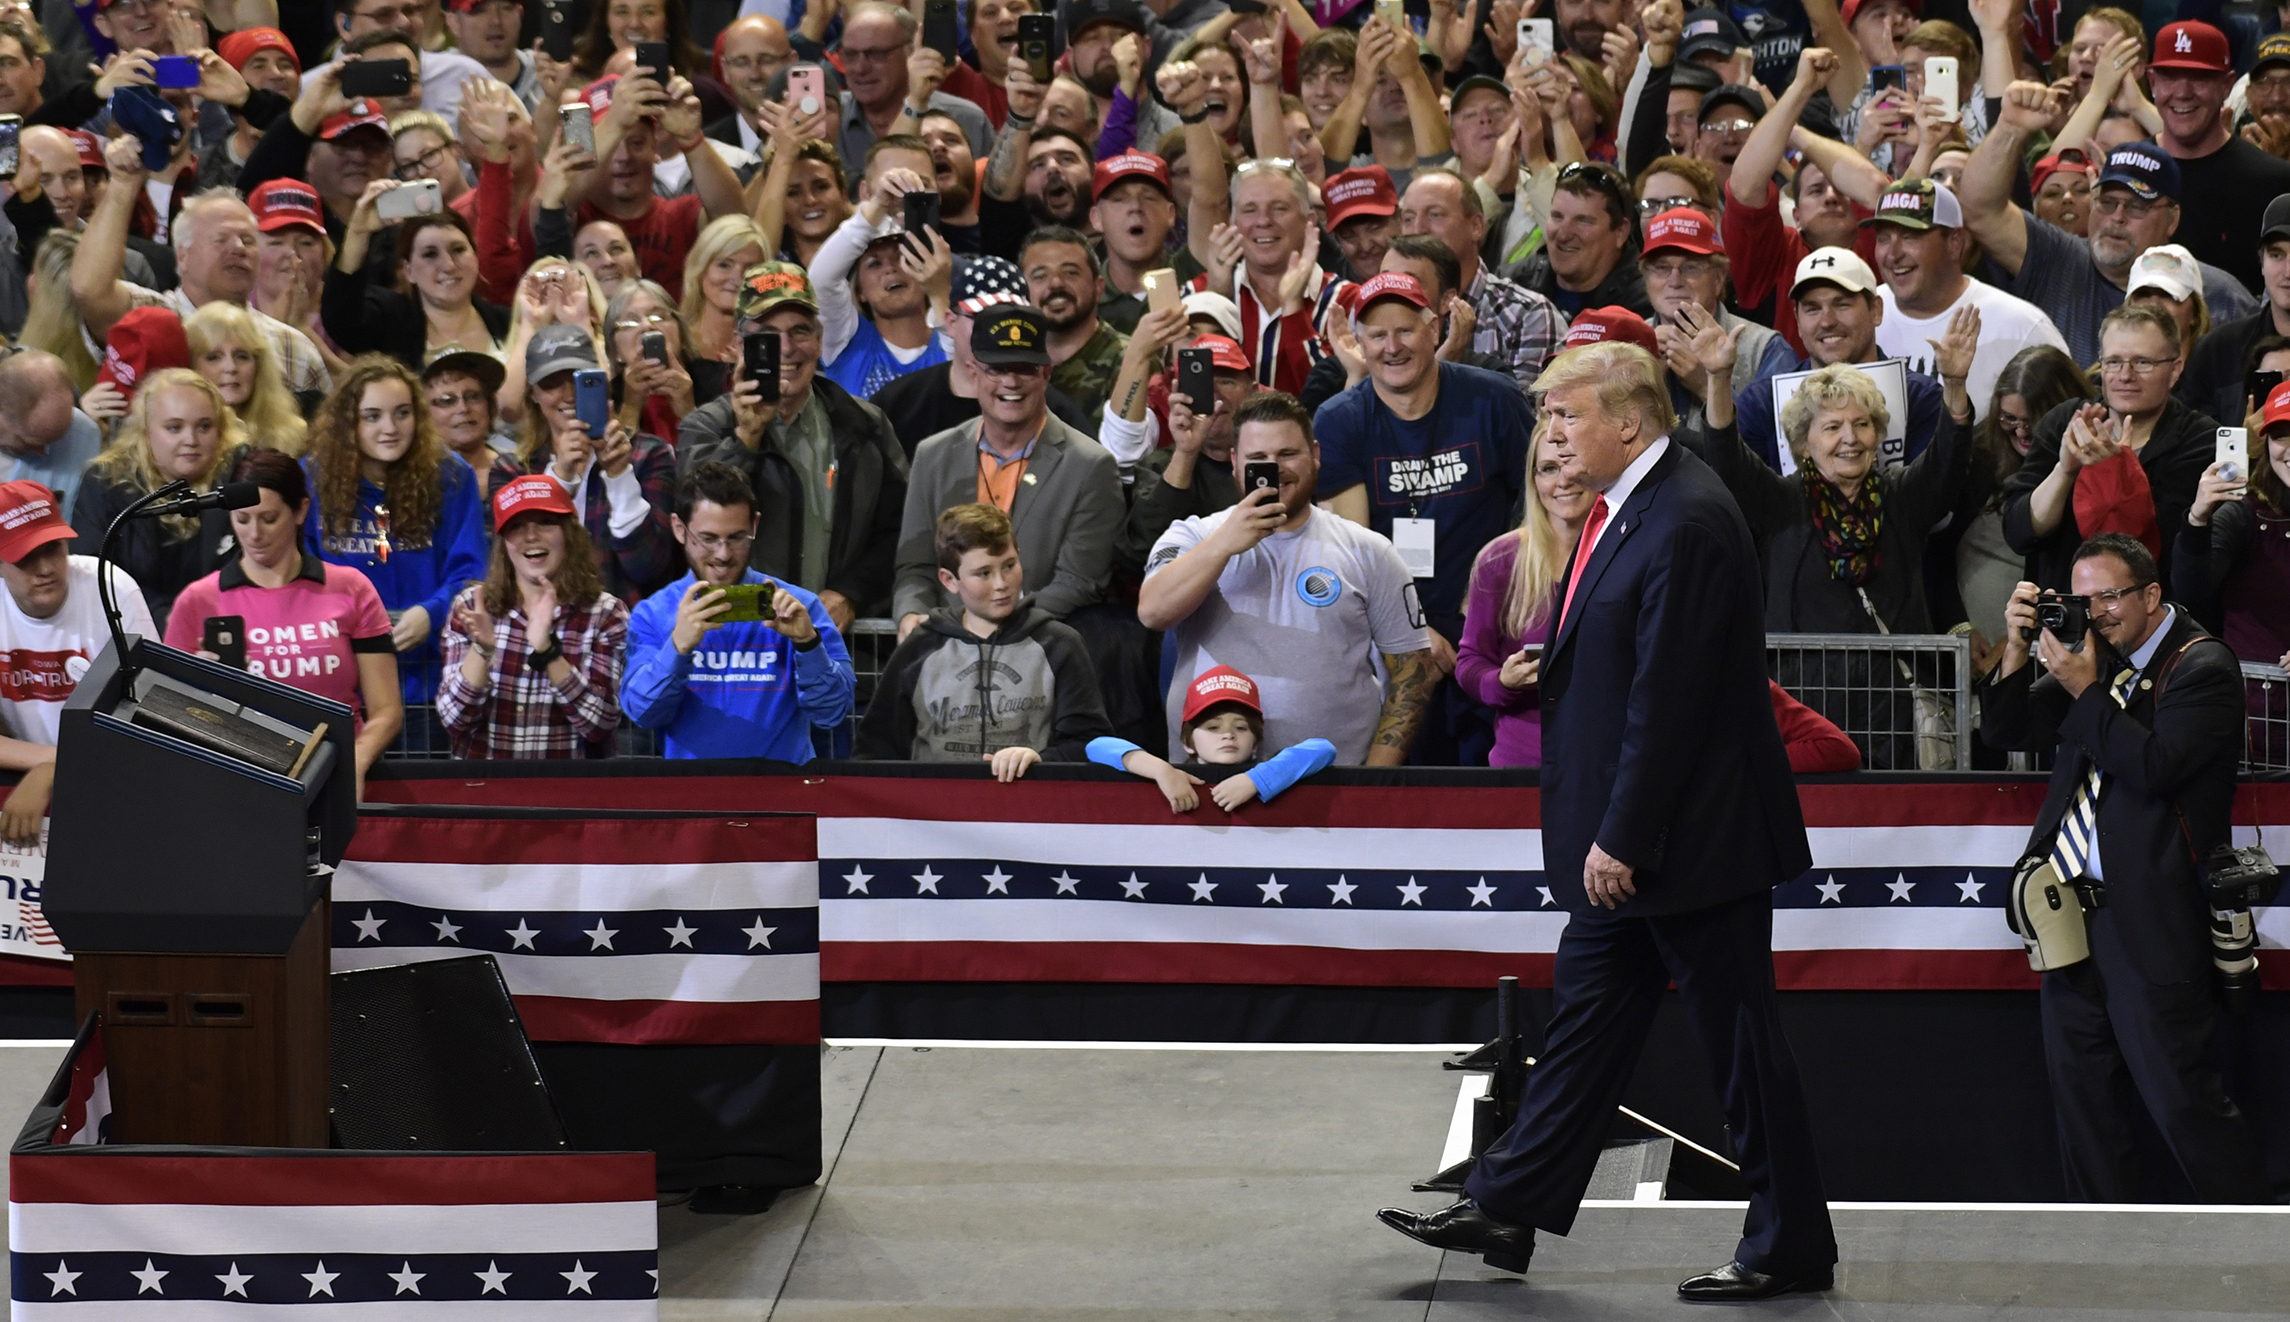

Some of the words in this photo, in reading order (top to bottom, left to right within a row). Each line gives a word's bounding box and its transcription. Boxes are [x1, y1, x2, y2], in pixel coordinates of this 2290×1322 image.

[2174, 28, 2192, 53] LA
[2110, 152, 2161, 172] TRUMP
[1880, 193, 1920, 211] MAGA
[1391, 460, 1429, 473] DRAIN
[1431, 451, 1461, 467] THE
[1388, 462, 1468, 492] SWAMP
[248, 620, 340, 644] OMEN
[263, 644, 301, 656] FOR
[692, 650, 778, 669] RUMP
[247, 655, 340, 679] RUMP
[1, 669, 35, 687] FOR
[40, 671, 74, 687] TRU
[1196, 676, 1218, 691] MAKE
[1219, 675, 1252, 689] AMERICA
[1200, 682, 1225, 695] GREAT
[1226, 682, 1250, 694] AGAIN
